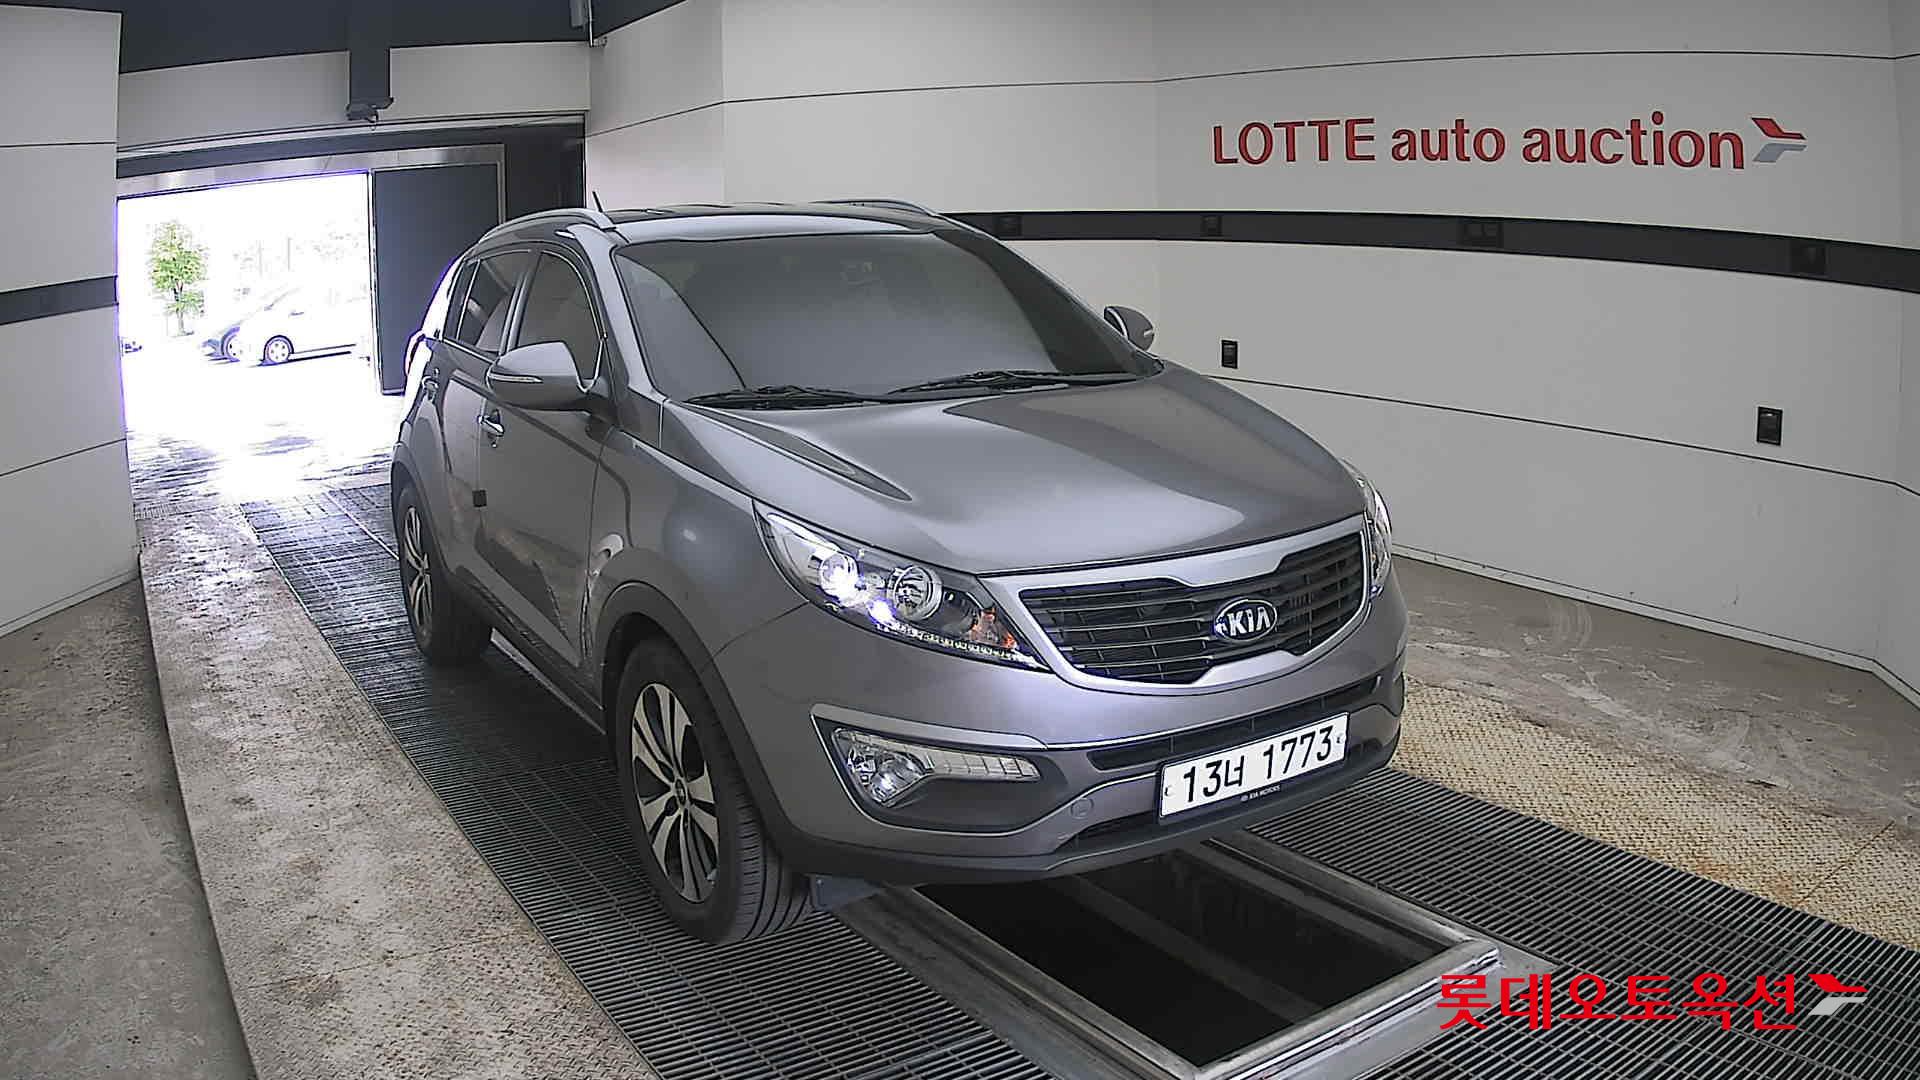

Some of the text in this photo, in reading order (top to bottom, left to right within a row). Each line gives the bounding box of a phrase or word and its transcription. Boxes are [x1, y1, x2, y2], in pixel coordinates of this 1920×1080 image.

[1213, 111, 1744, 169] LOTTE auto auction
[1227, 606, 1271, 637] KIA
[1183, 725, 1333, 803] 13너 1773
